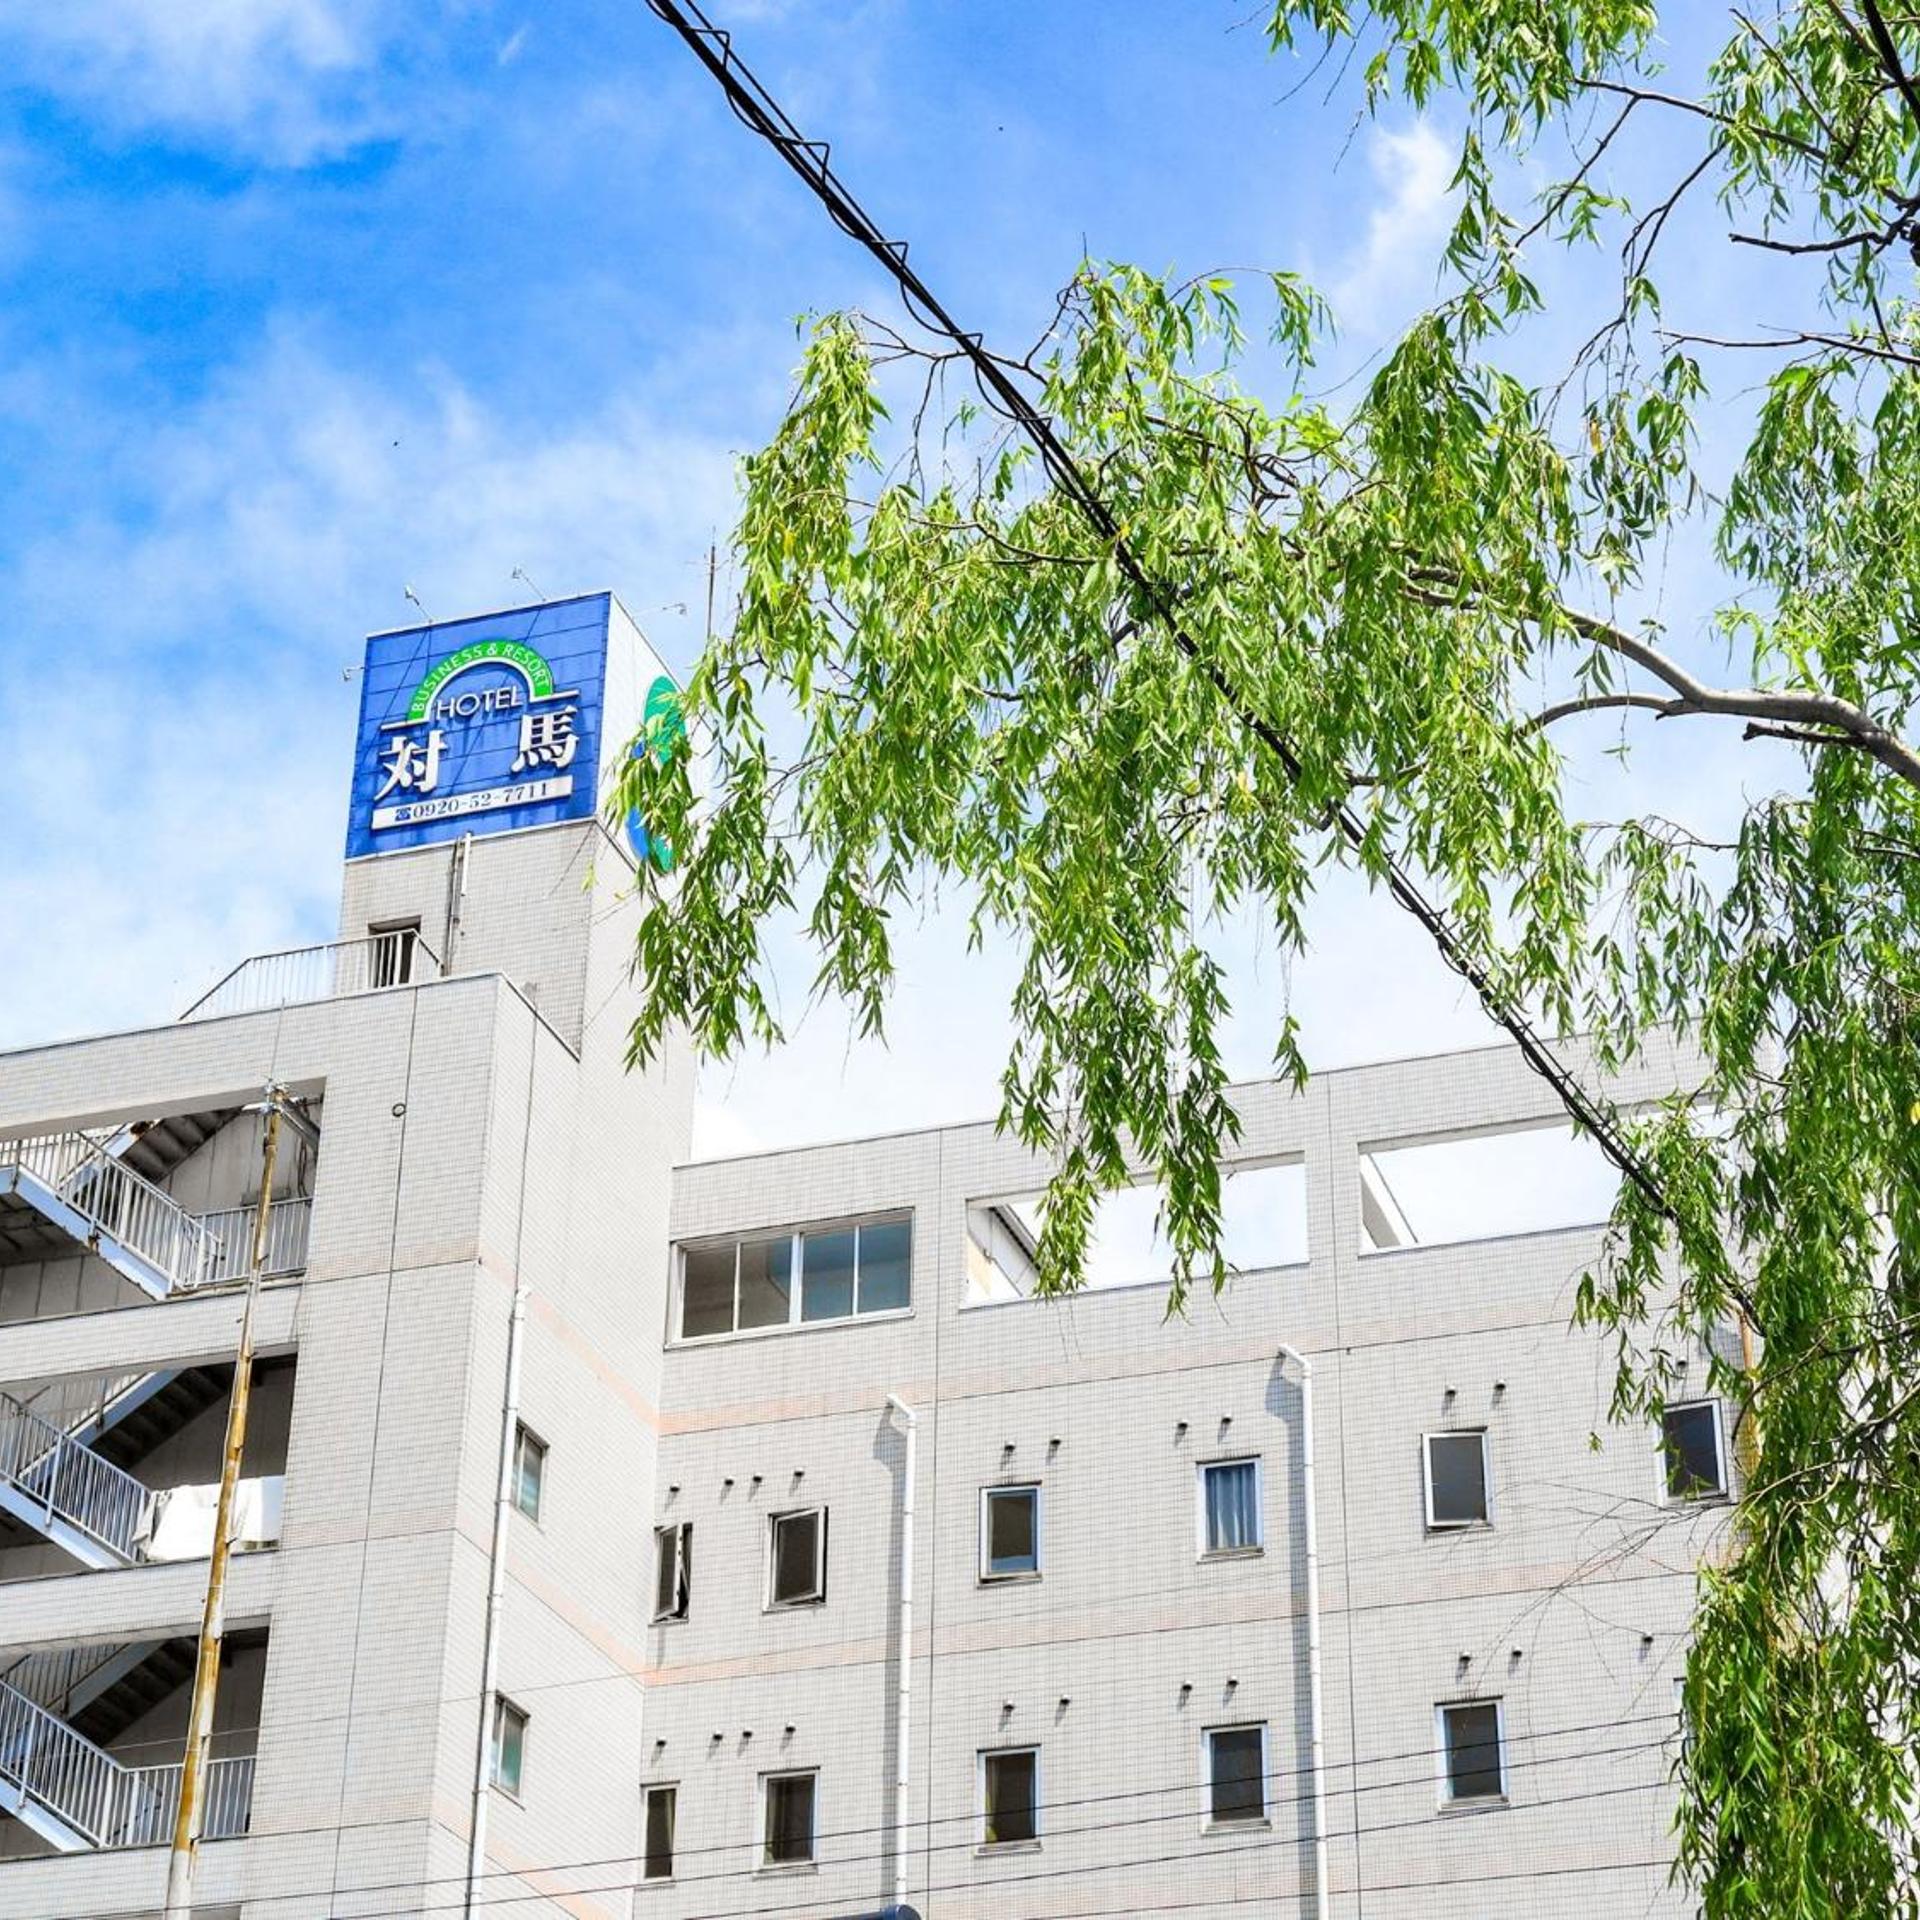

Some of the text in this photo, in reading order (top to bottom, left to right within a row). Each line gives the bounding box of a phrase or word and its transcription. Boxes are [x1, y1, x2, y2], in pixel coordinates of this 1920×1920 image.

[411, 642, 551, 712] BUSINESS & RESORT
[436, 685, 523, 720] HOTEL
[374, 705, 580, 801] 対馬
[413, 782, 548, 818] 0920-52-7711
